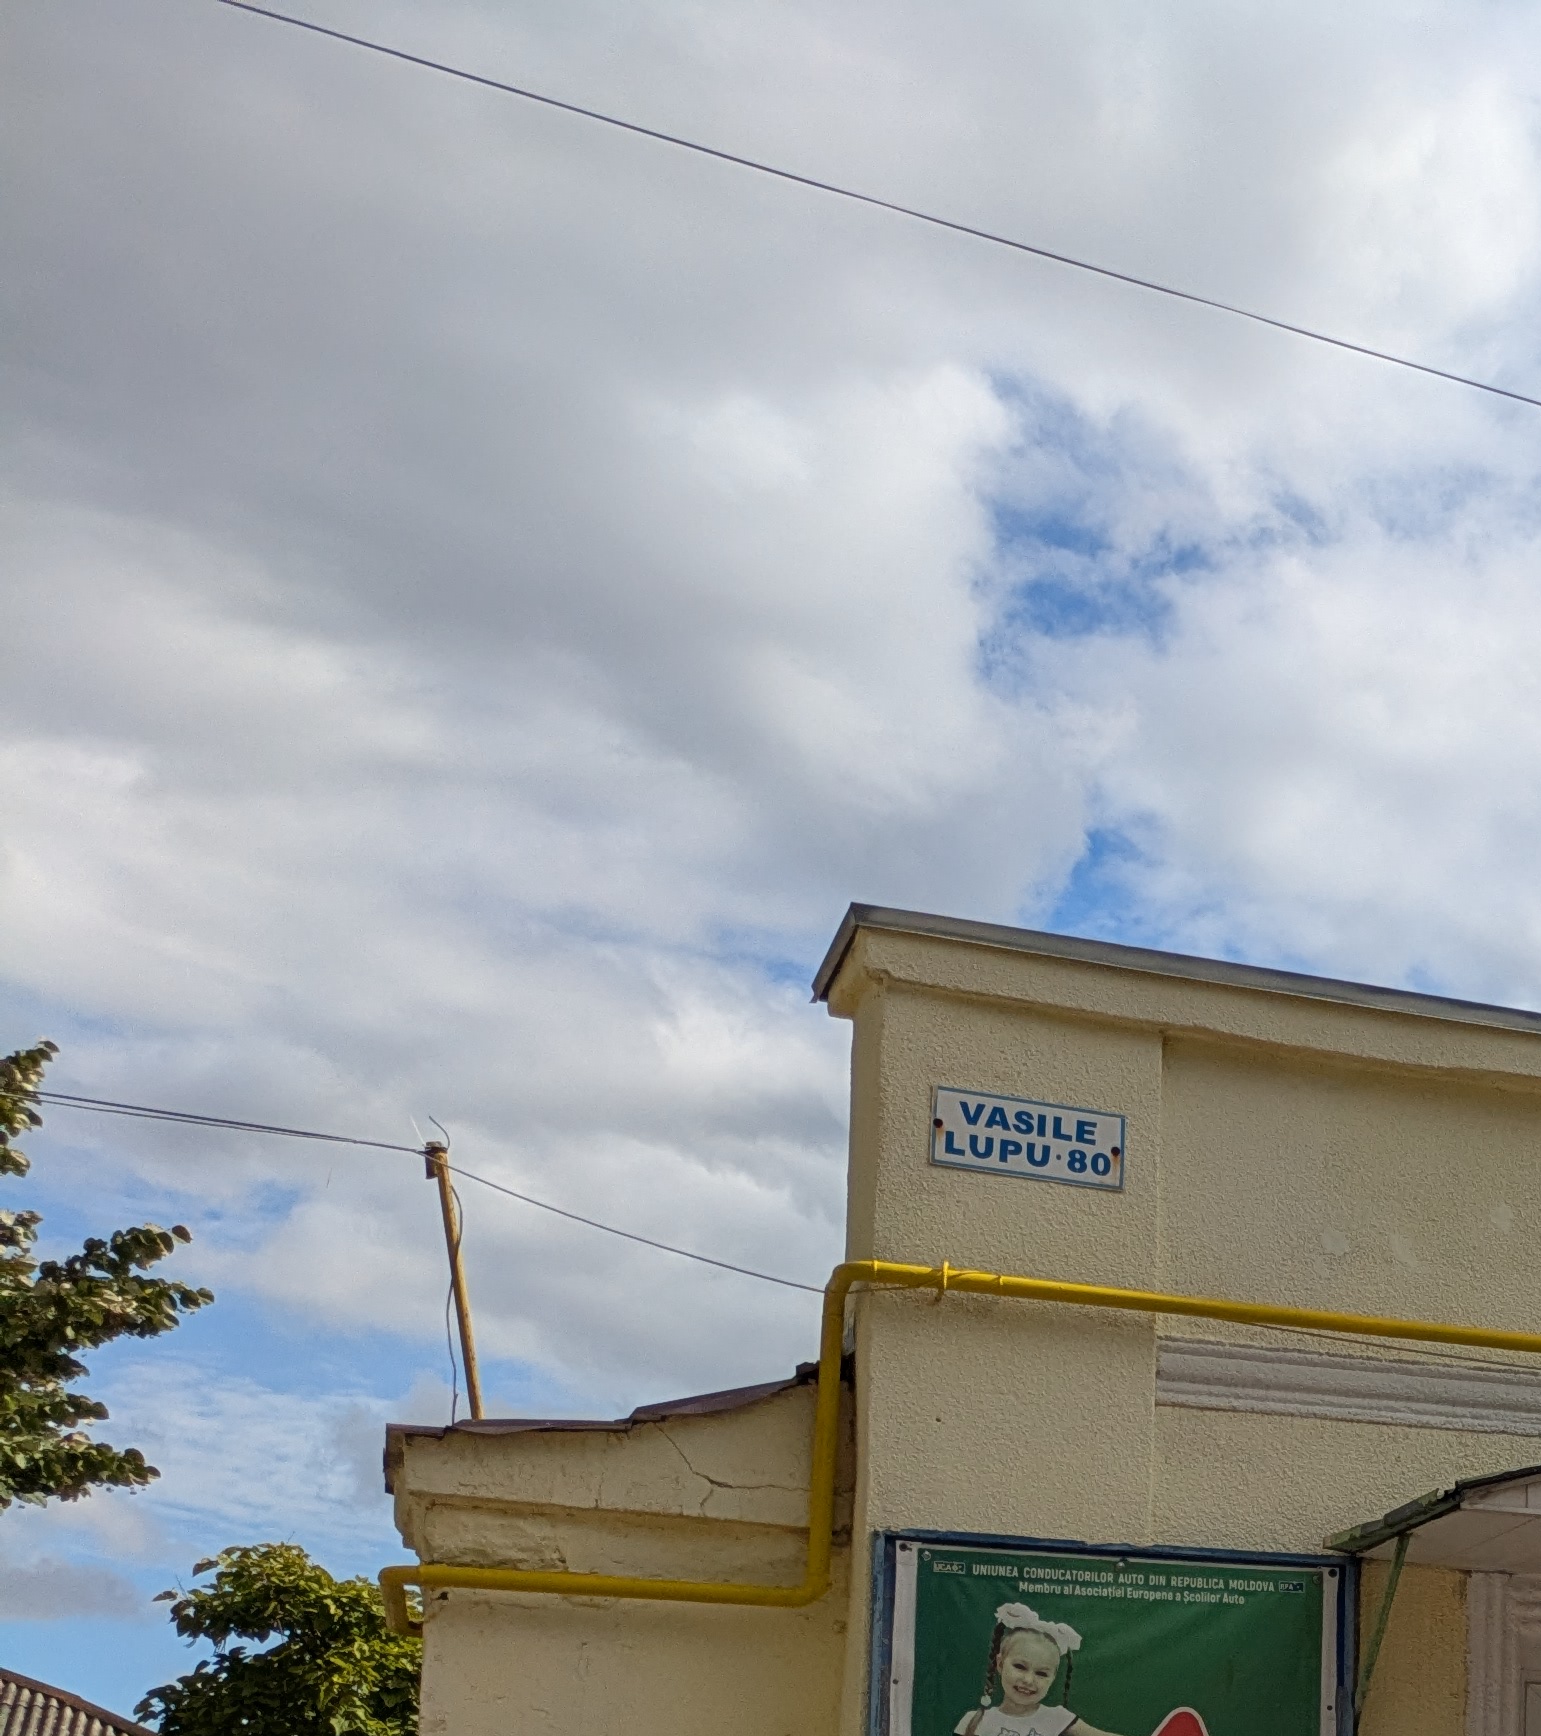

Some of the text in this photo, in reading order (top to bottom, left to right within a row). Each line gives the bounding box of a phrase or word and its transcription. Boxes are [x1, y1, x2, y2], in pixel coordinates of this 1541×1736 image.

[959, 1101, 1098, 1146] VASILE
[944, 1130, 1112, 1177] LUPU 80
[972, 1564, 1018, 1577] UNIUNEA
[1023, 1567, 1114, 1583] CONDUCATORILOR
[1118, 1573, 1144, 1586] AUTO
[1149, 1575, 1166, 1587] DIN
[1170, 1576, 1225, 1590] REPUBLICA
[1229, 1579, 1275, 1592] MOLDOVA
[1019, 1581, 1062, 1595] Membru
[1063, 1584, 1073, 1595] al
[1126, 1587, 1173, 1602] Europene
[1175, 1592, 1182, 1602] a
[1222, 1592, 1245, 1605] Auto
